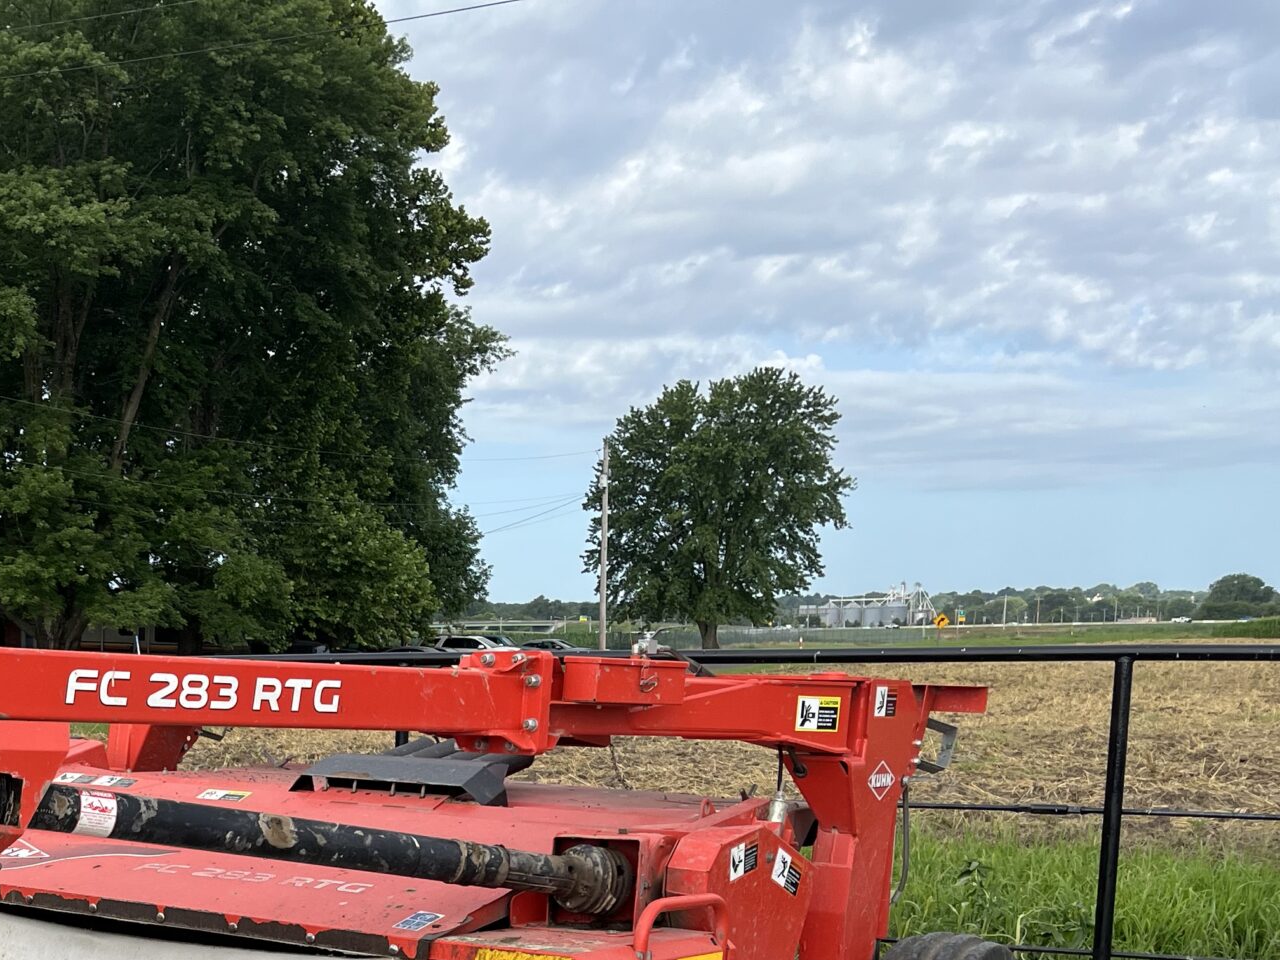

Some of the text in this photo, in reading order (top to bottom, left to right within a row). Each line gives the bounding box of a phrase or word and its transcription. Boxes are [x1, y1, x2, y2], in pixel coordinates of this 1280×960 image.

[64, 668, 342, 713] FC 283 RTG
[871, 772, 892, 788] KUHN
[132, 863, 374, 894] FC 283 RTG
